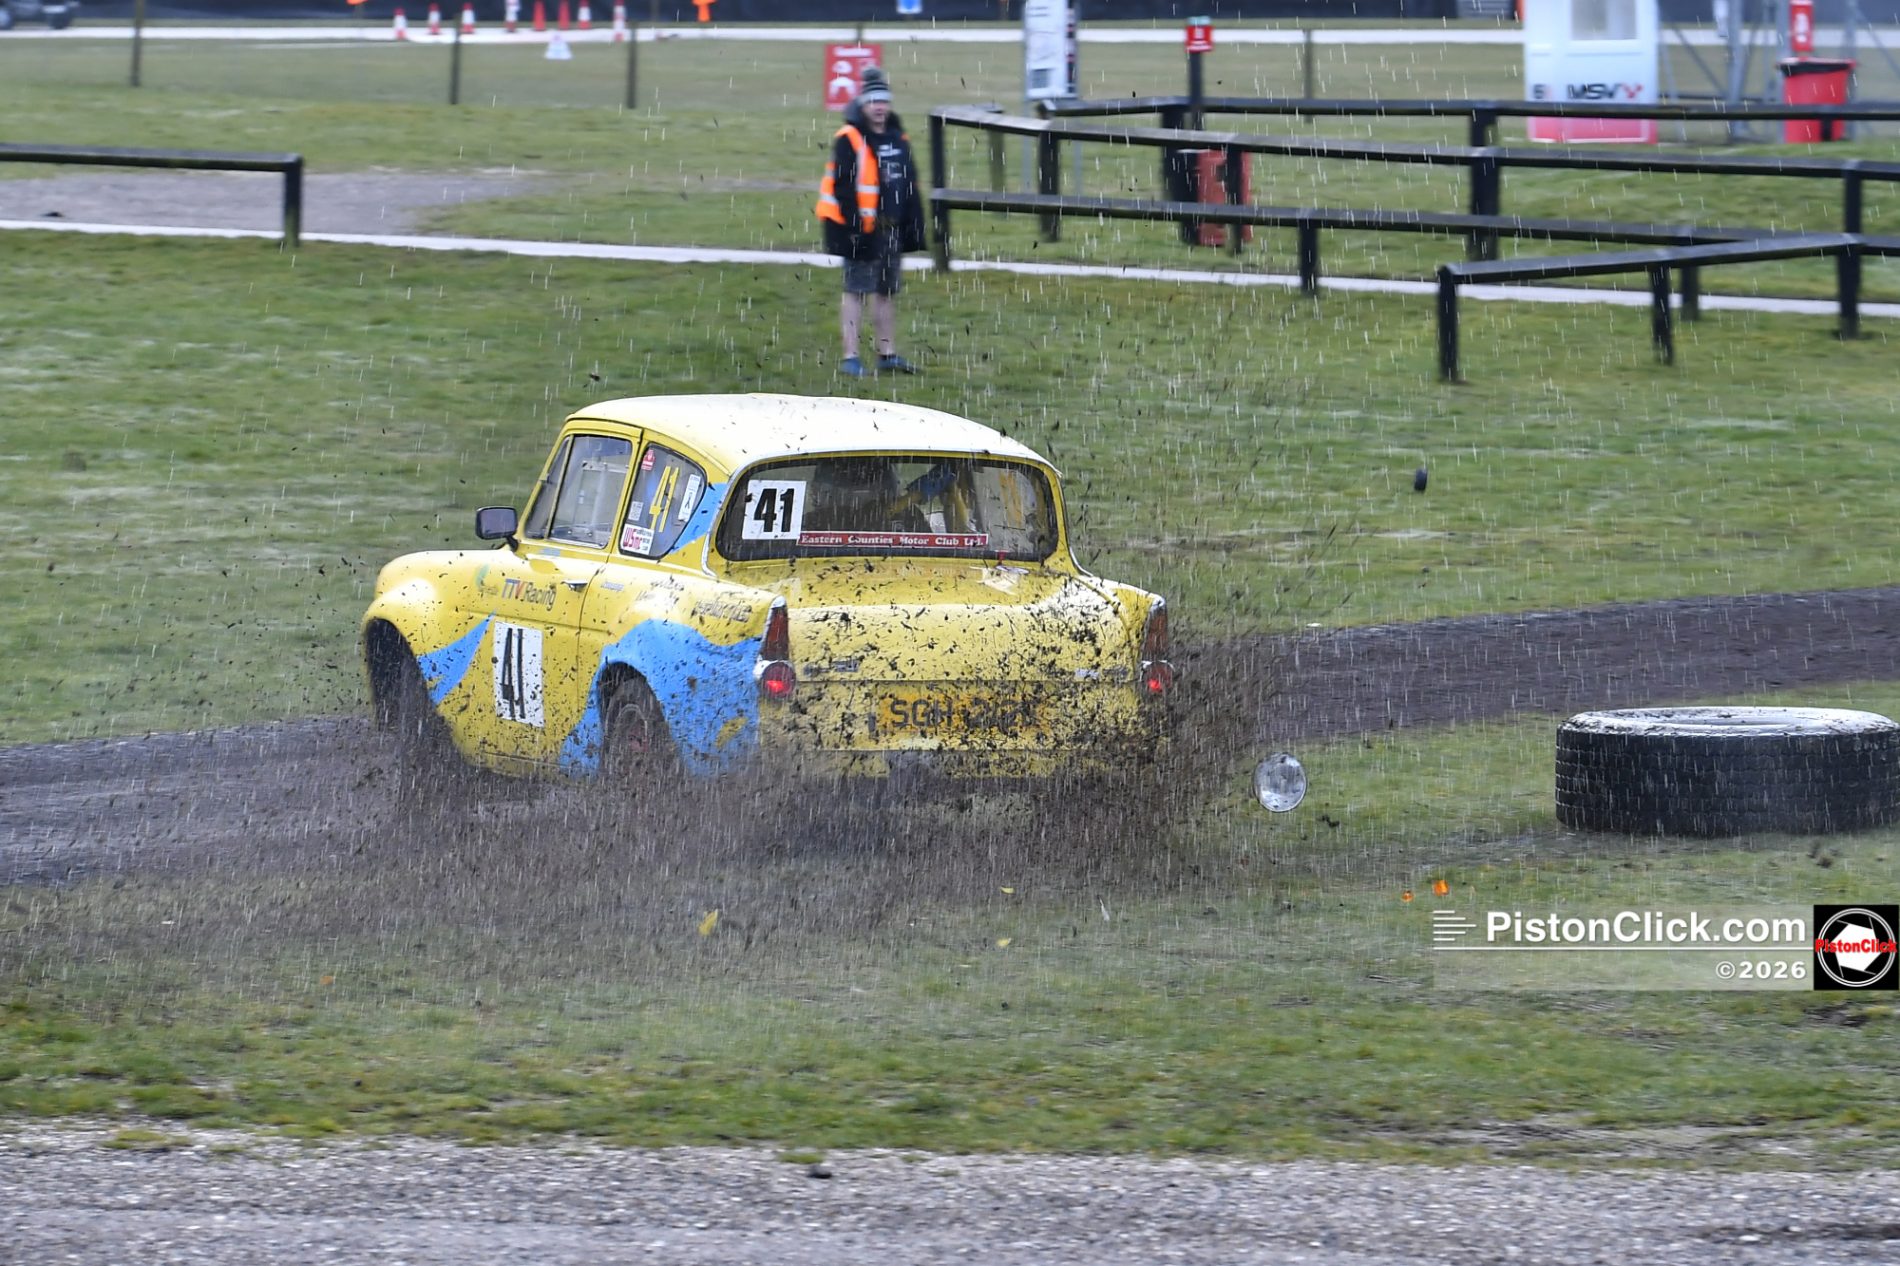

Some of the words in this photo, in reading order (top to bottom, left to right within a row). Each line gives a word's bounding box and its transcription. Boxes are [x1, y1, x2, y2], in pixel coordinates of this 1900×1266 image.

[649, 466, 678, 532] 41
[754, 488, 794, 532] 41
[801, 534, 843, 544] Eastern
[847, 535, 894, 545] Counties
[900, 536, 930, 545] Motor
[935, 536, 960, 546] Club
[525, 581, 557, 611] Racing
[501, 627, 525, 719] 41
